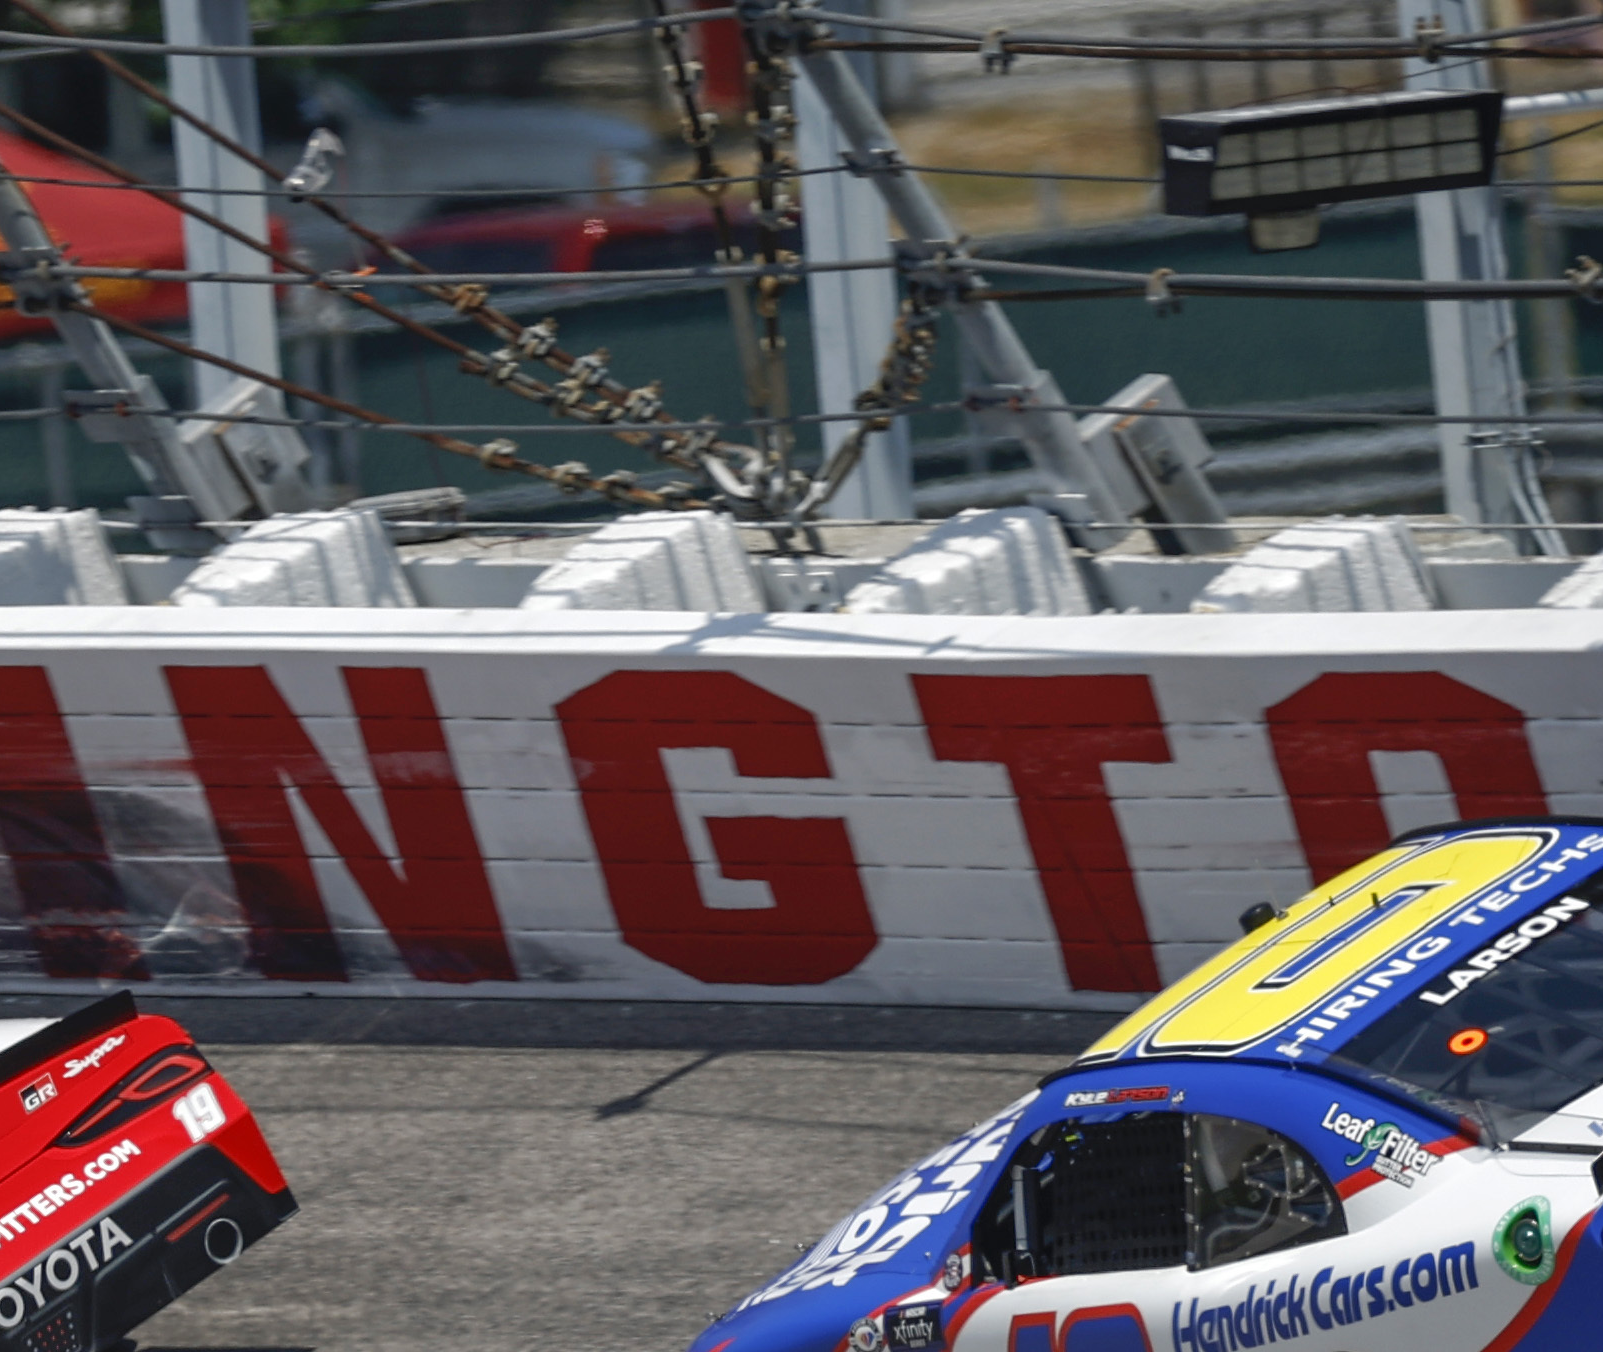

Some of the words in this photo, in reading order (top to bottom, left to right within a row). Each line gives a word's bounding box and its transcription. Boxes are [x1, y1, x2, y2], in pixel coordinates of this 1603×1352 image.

[1419, 896, 1591, 1007] LARSON
[1276, 935, 1452, 1059] HIRING
[23, 1082, 57, 1112] GR
[62, 1034, 126, 1078] Supra
[172, 1083, 226, 1143] 19
[1321, 1102, 1376, 1143] Leaf
[1380, 1130, 1439, 1176] Filter
[893, 1319, 933, 1344] xfinity
